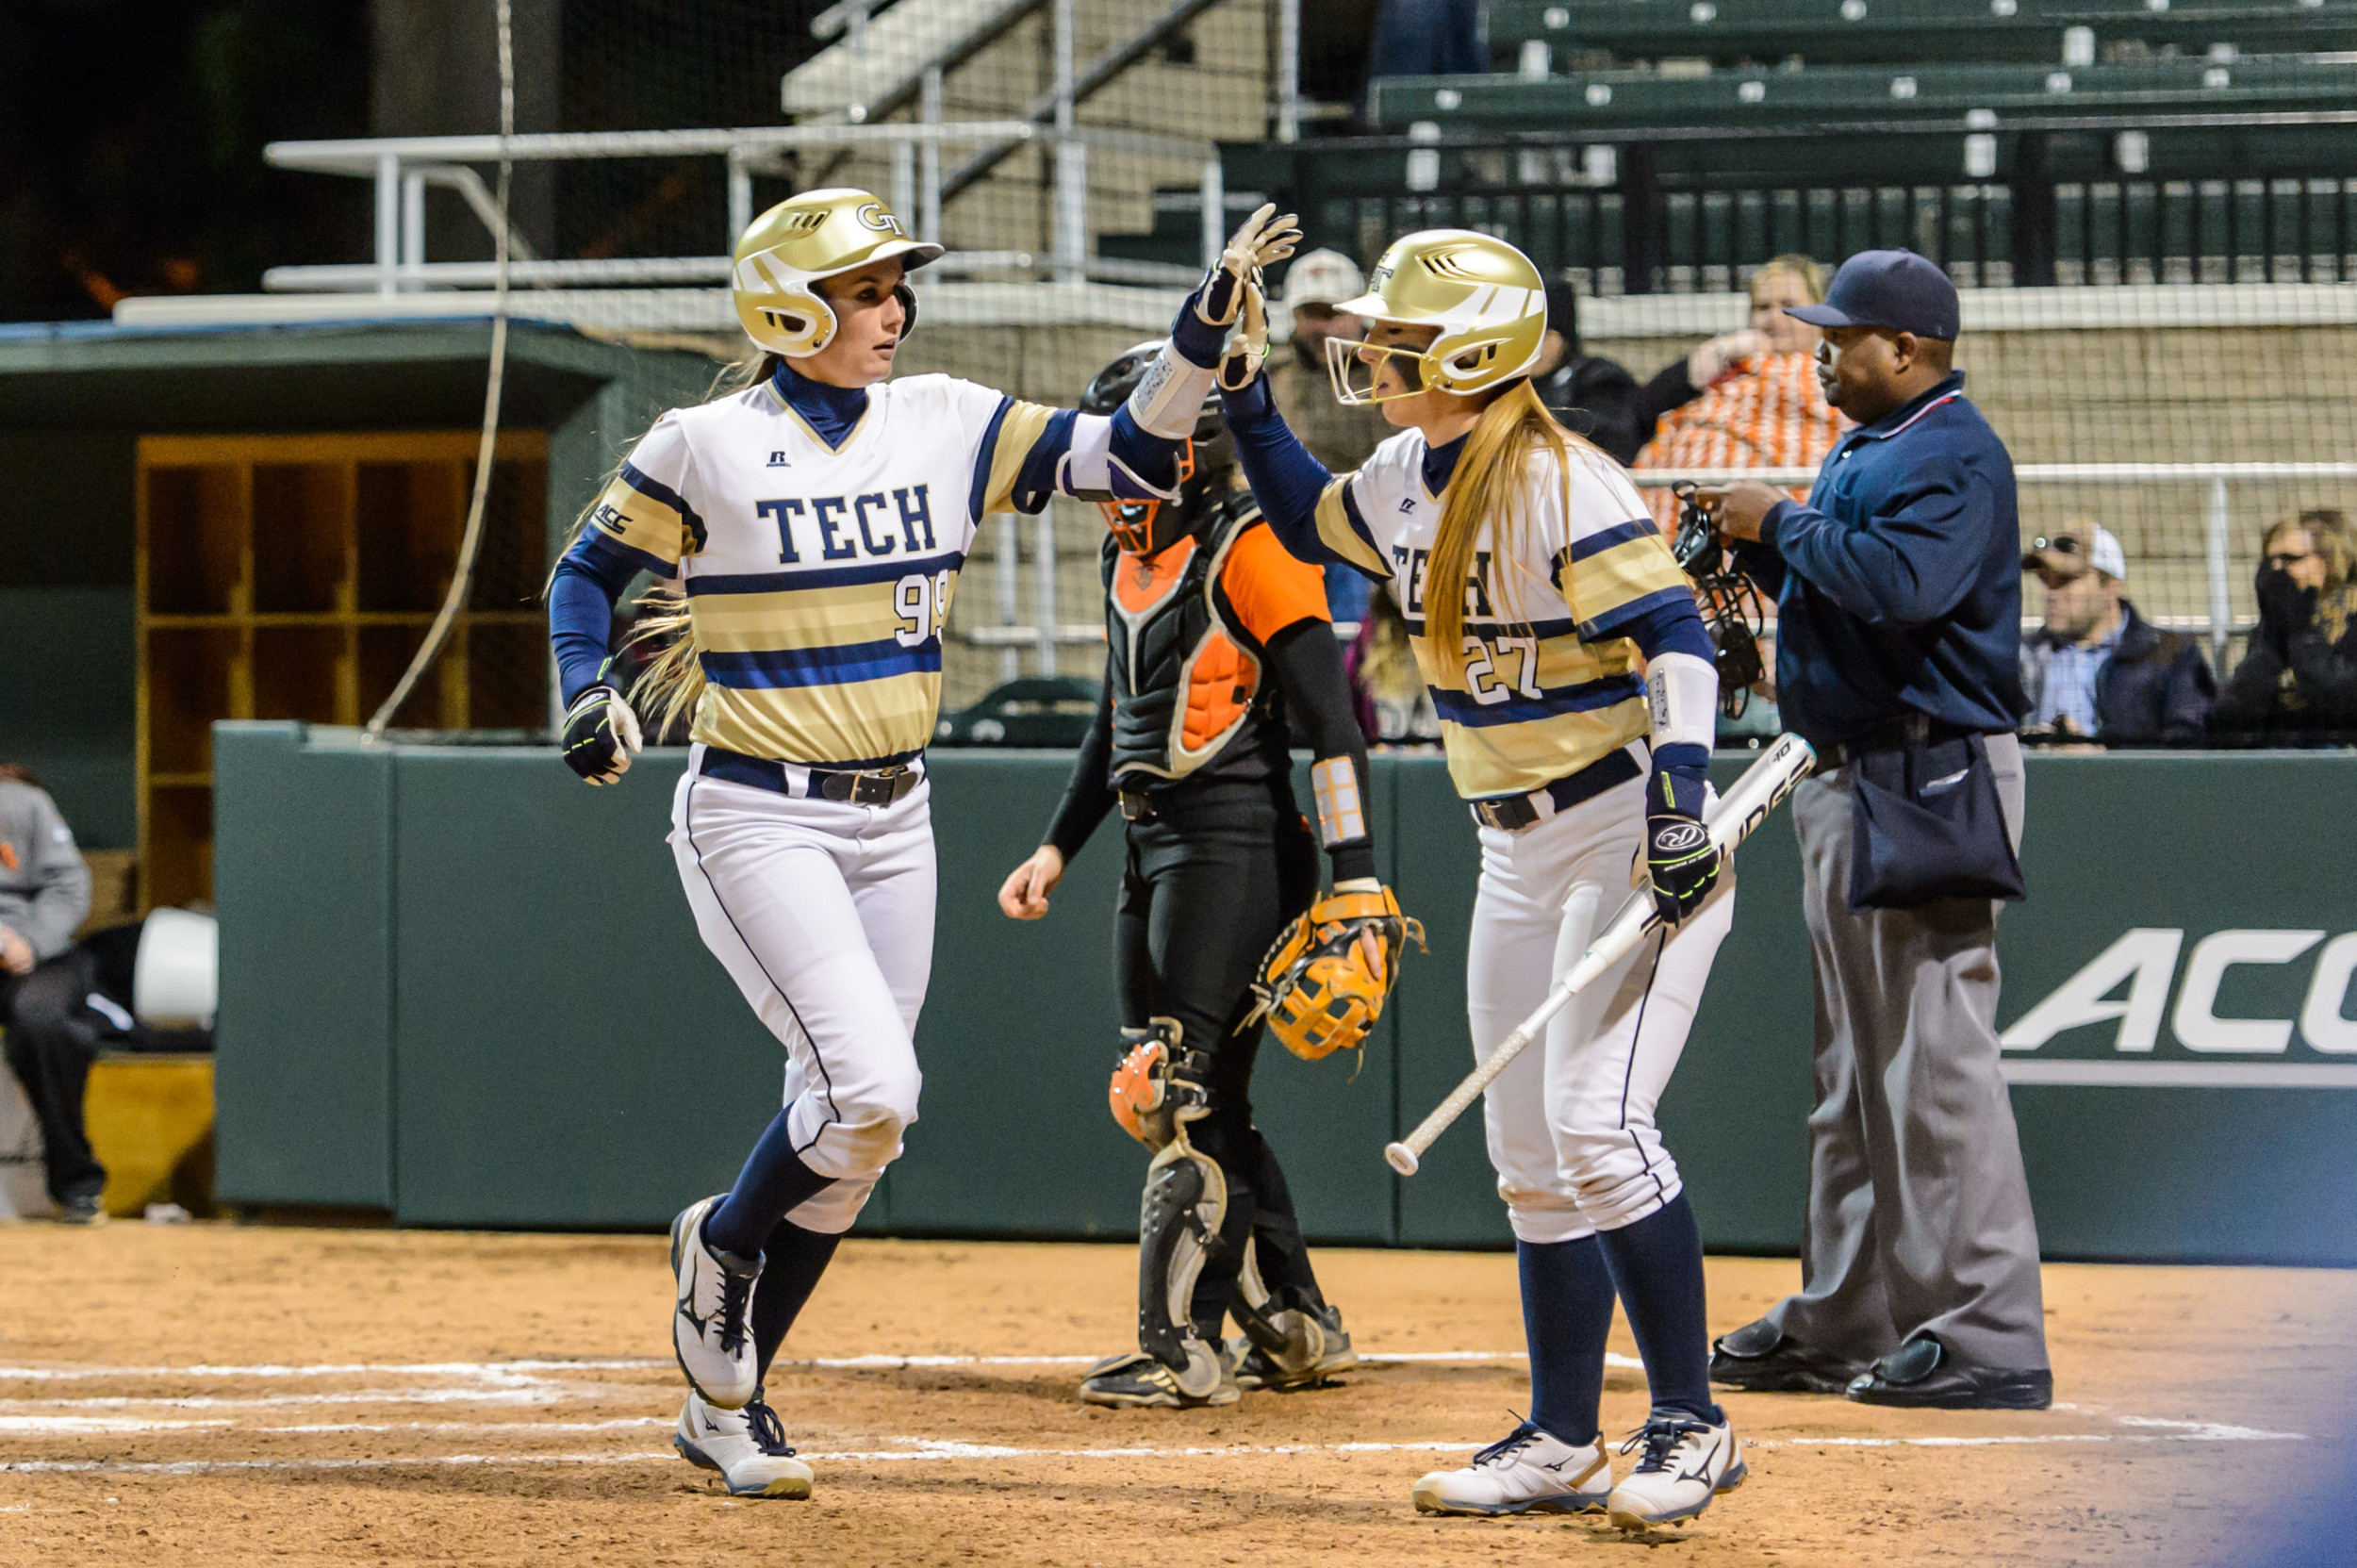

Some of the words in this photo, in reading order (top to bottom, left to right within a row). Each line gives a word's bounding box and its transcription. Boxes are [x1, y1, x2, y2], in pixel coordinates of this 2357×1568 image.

[596, 503, 634, 531] ACC
[755, 483, 937, 565] TECH
[1392, 544, 1495, 617] EH
[1462, 635, 1543, 706] 27
